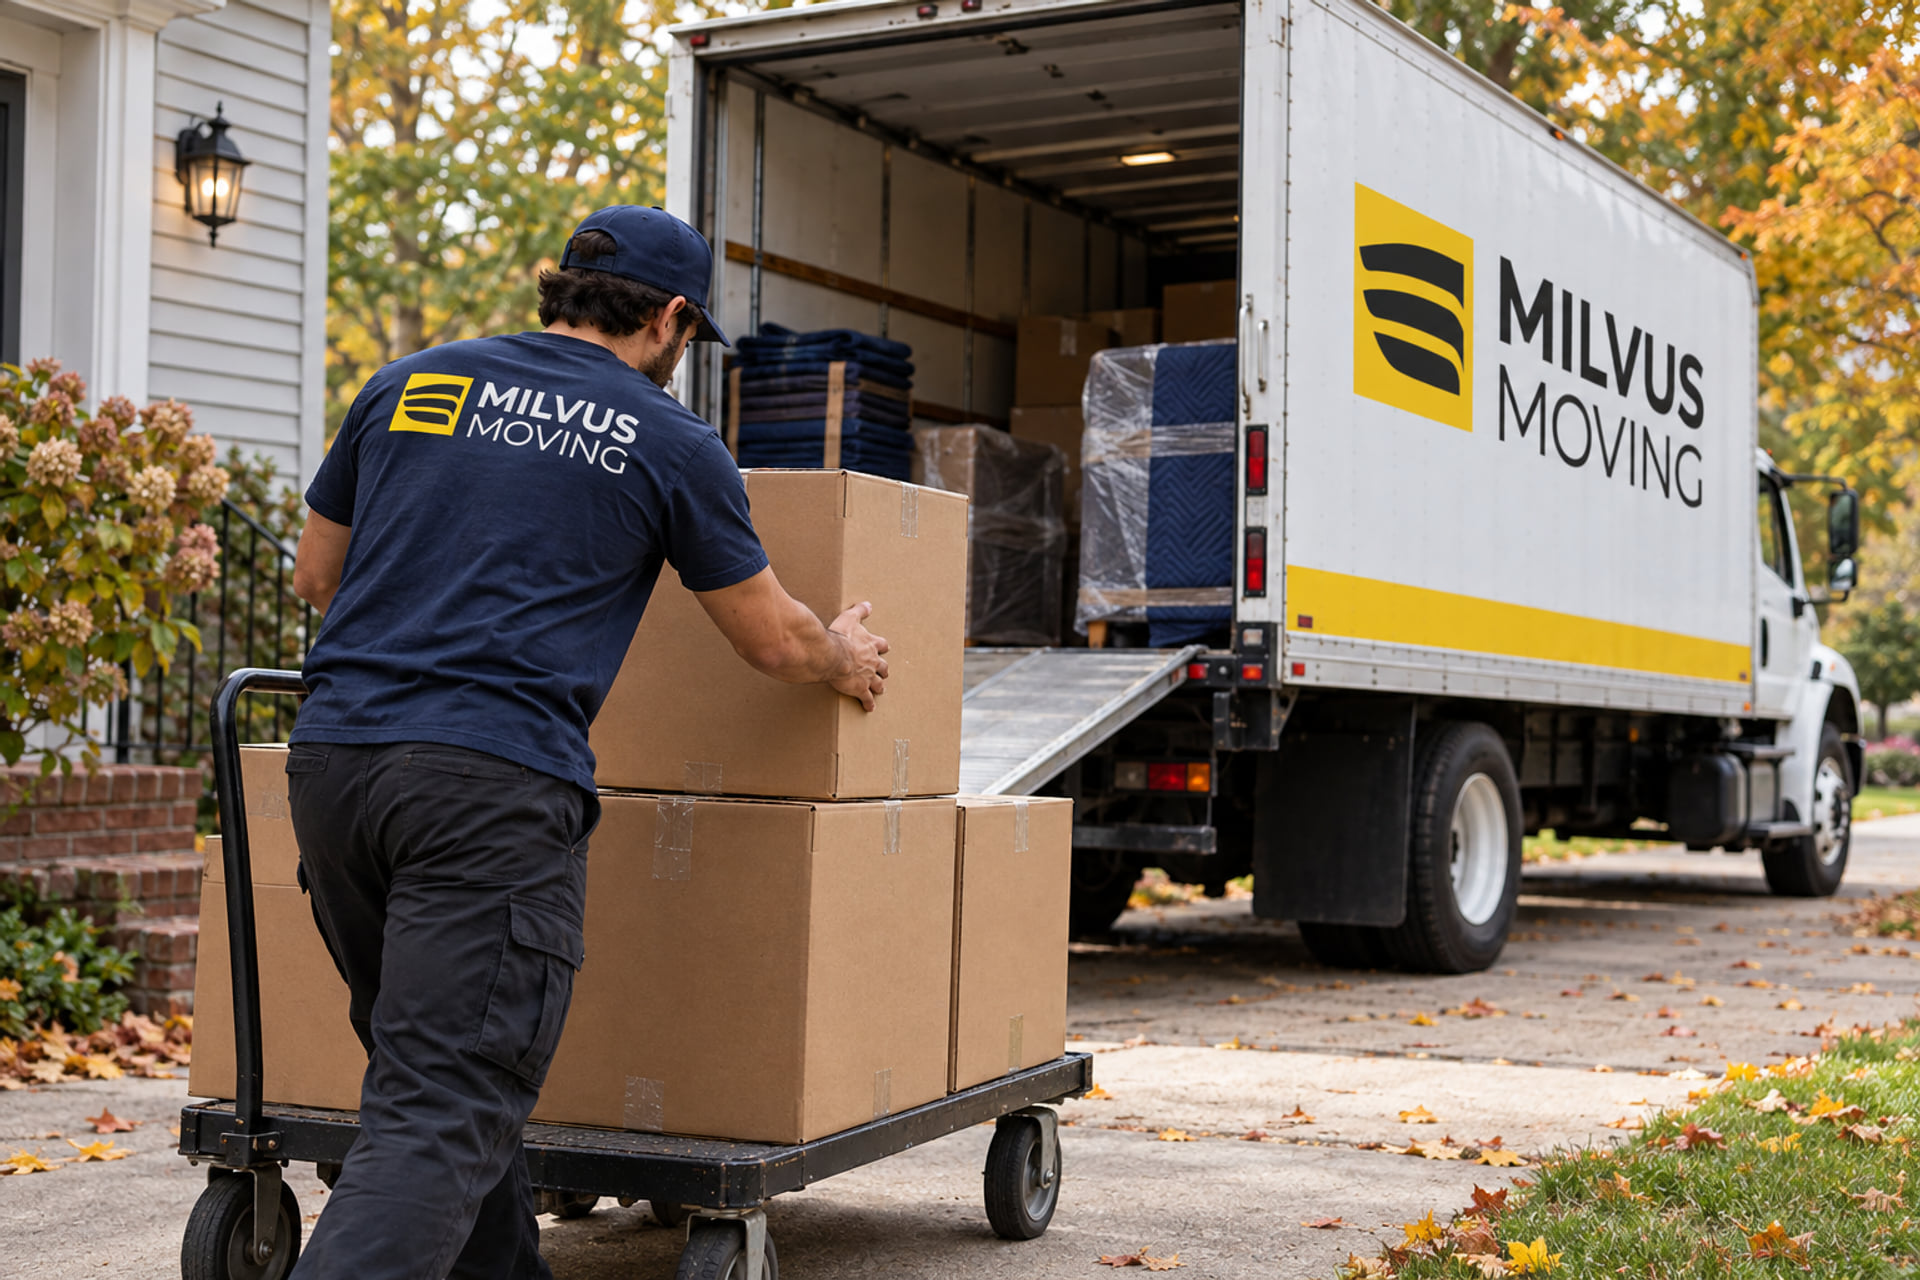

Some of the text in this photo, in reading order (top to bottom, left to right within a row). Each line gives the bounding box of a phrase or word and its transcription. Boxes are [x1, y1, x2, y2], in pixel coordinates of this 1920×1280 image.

[1500, 255, 1704, 429] MILVUS
[466, 413, 628, 474] MOVING
[477, 381, 640, 444] MILVUS
[1499, 363, 1702, 508] MOVING
